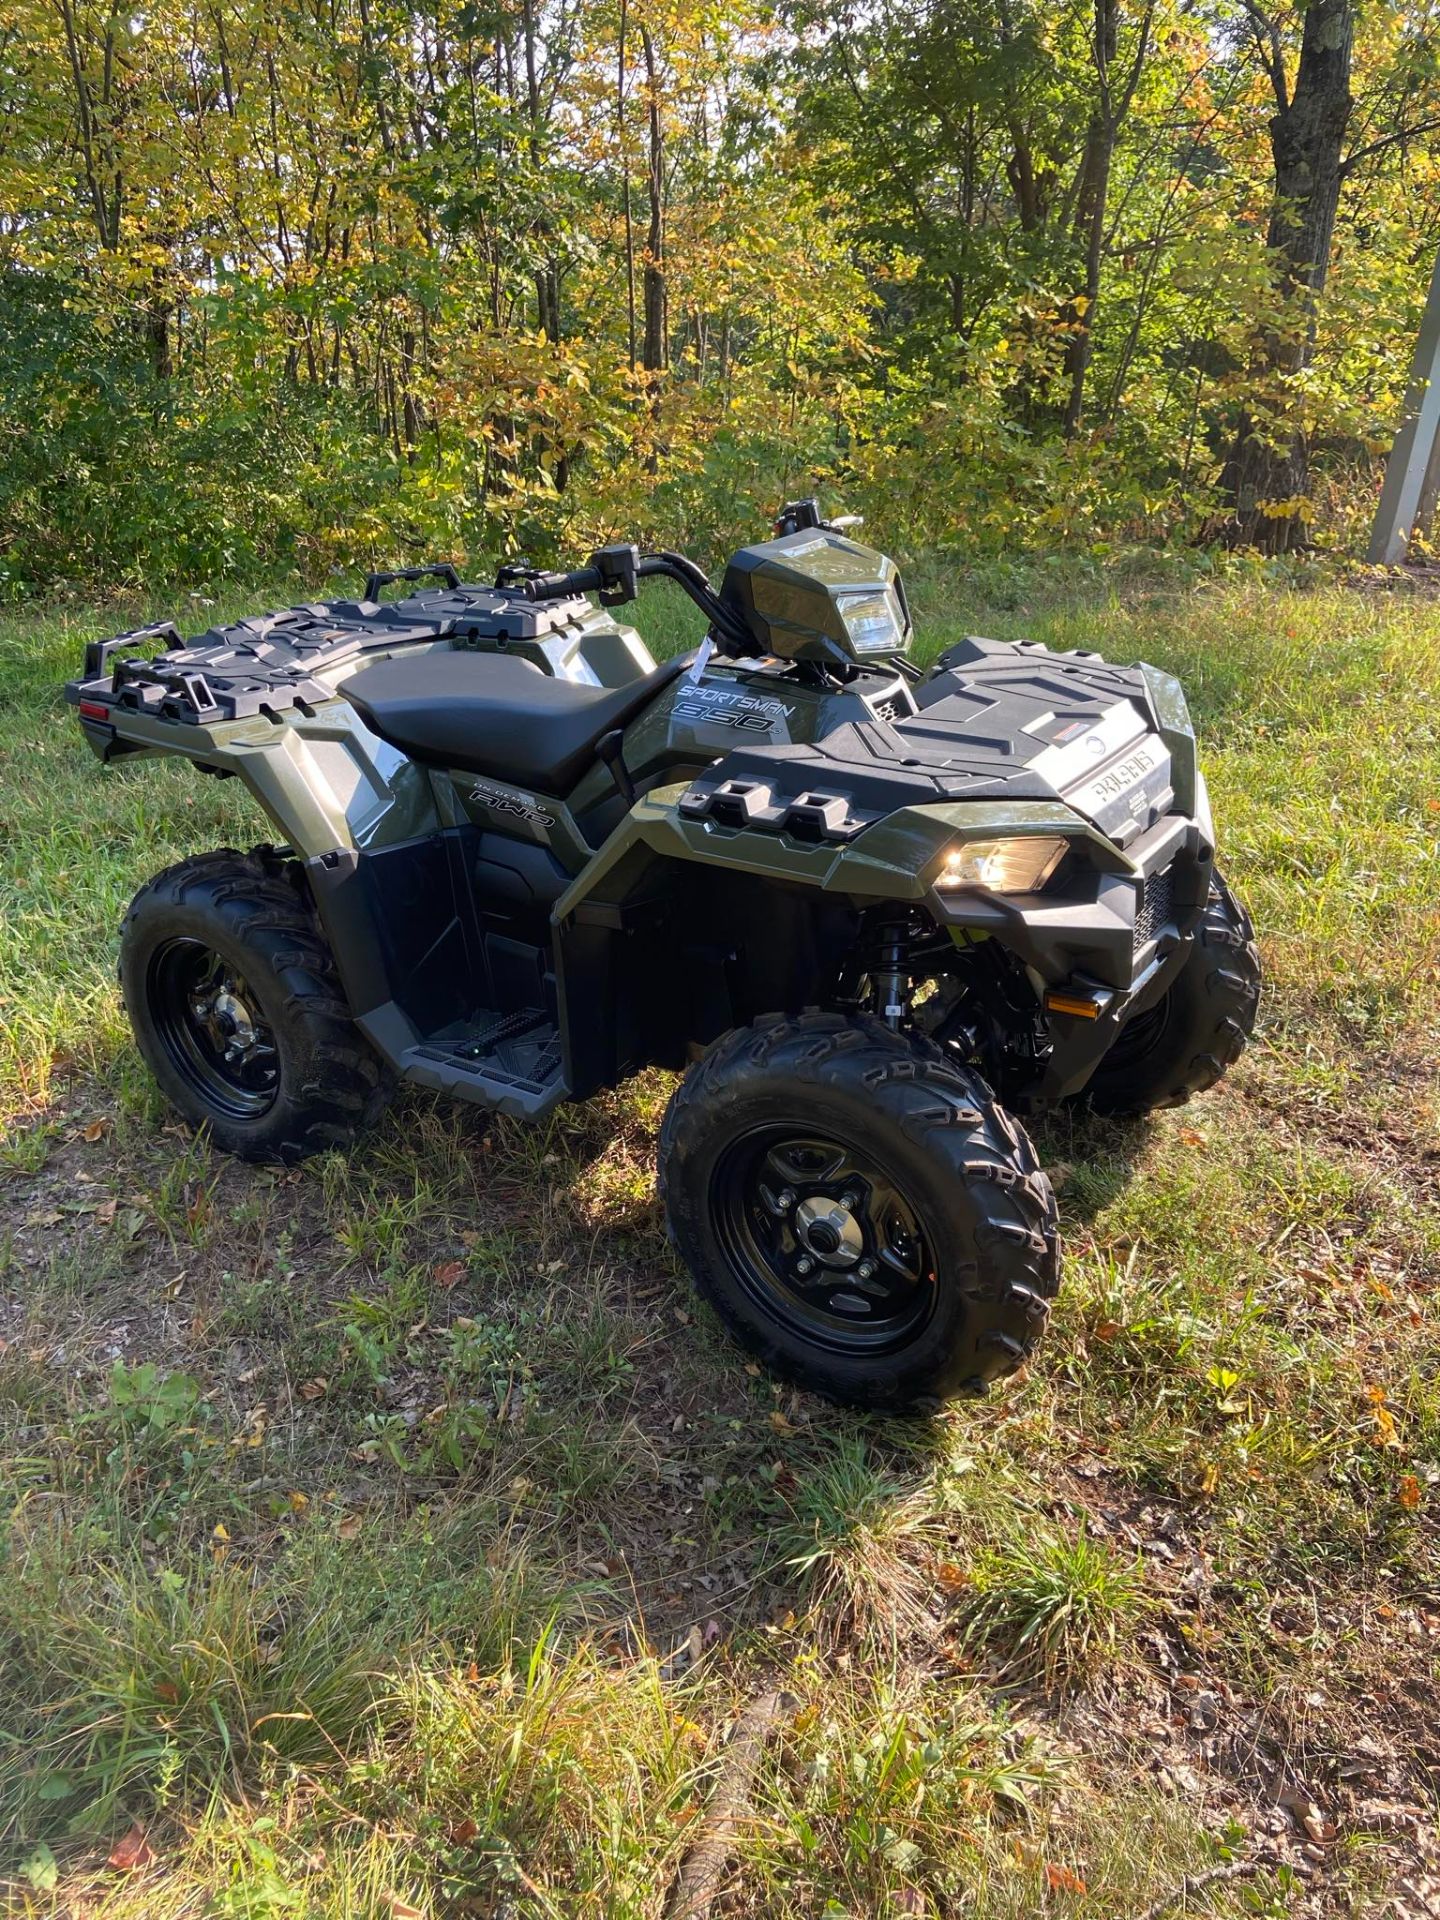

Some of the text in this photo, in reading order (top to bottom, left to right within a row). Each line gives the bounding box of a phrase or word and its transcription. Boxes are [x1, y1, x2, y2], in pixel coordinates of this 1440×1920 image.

[671, 701, 776, 732] 850
[677, 685, 796, 717] SPORTSMAN
[474, 782, 491, 792] ON
[469, 790, 555, 827] AWD
